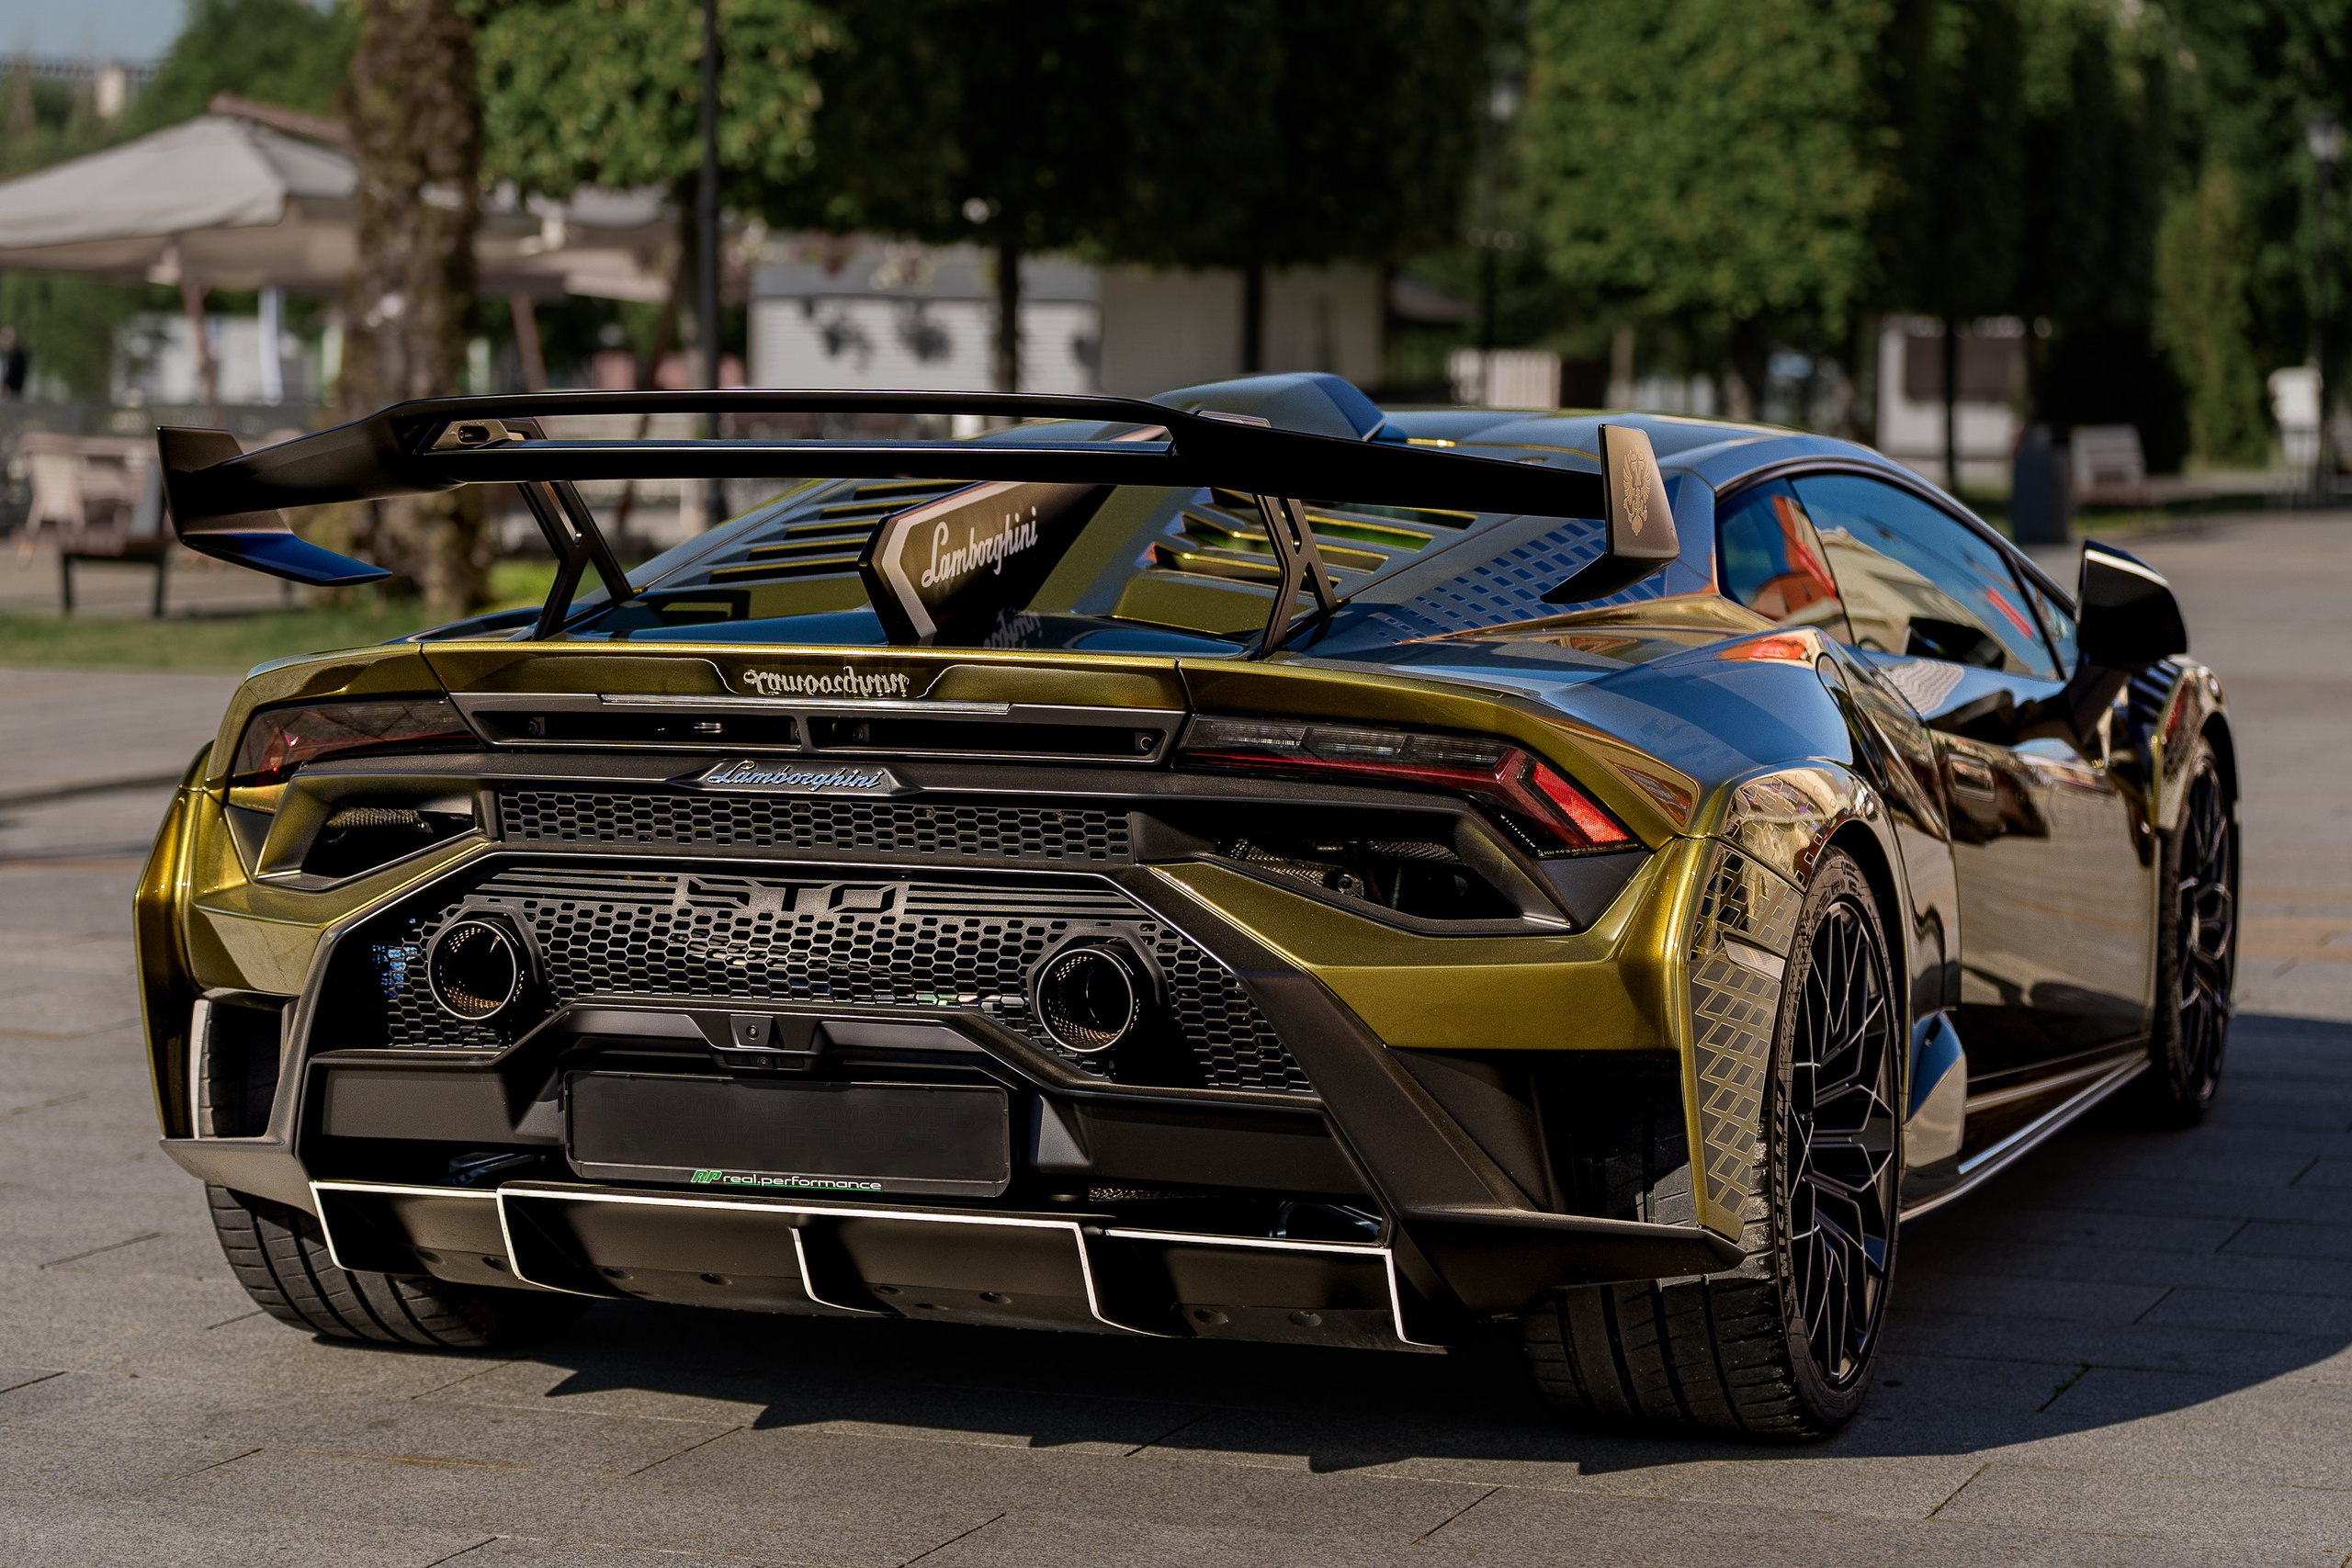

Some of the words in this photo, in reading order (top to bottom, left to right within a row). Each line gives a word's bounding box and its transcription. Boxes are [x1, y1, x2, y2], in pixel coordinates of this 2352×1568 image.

[921, 506, 1038, 588] Lamborghini
[707, 759, 885, 791] Lamborghini
[686, 876, 897, 914] STO
[600, 1091, 738, 1119] ПРОСИМ
[690, 1169, 723, 1183] RP
[723, 1173, 882, 1190] real.performance
[1775, 1089, 1789, 1278] MICHELIN
